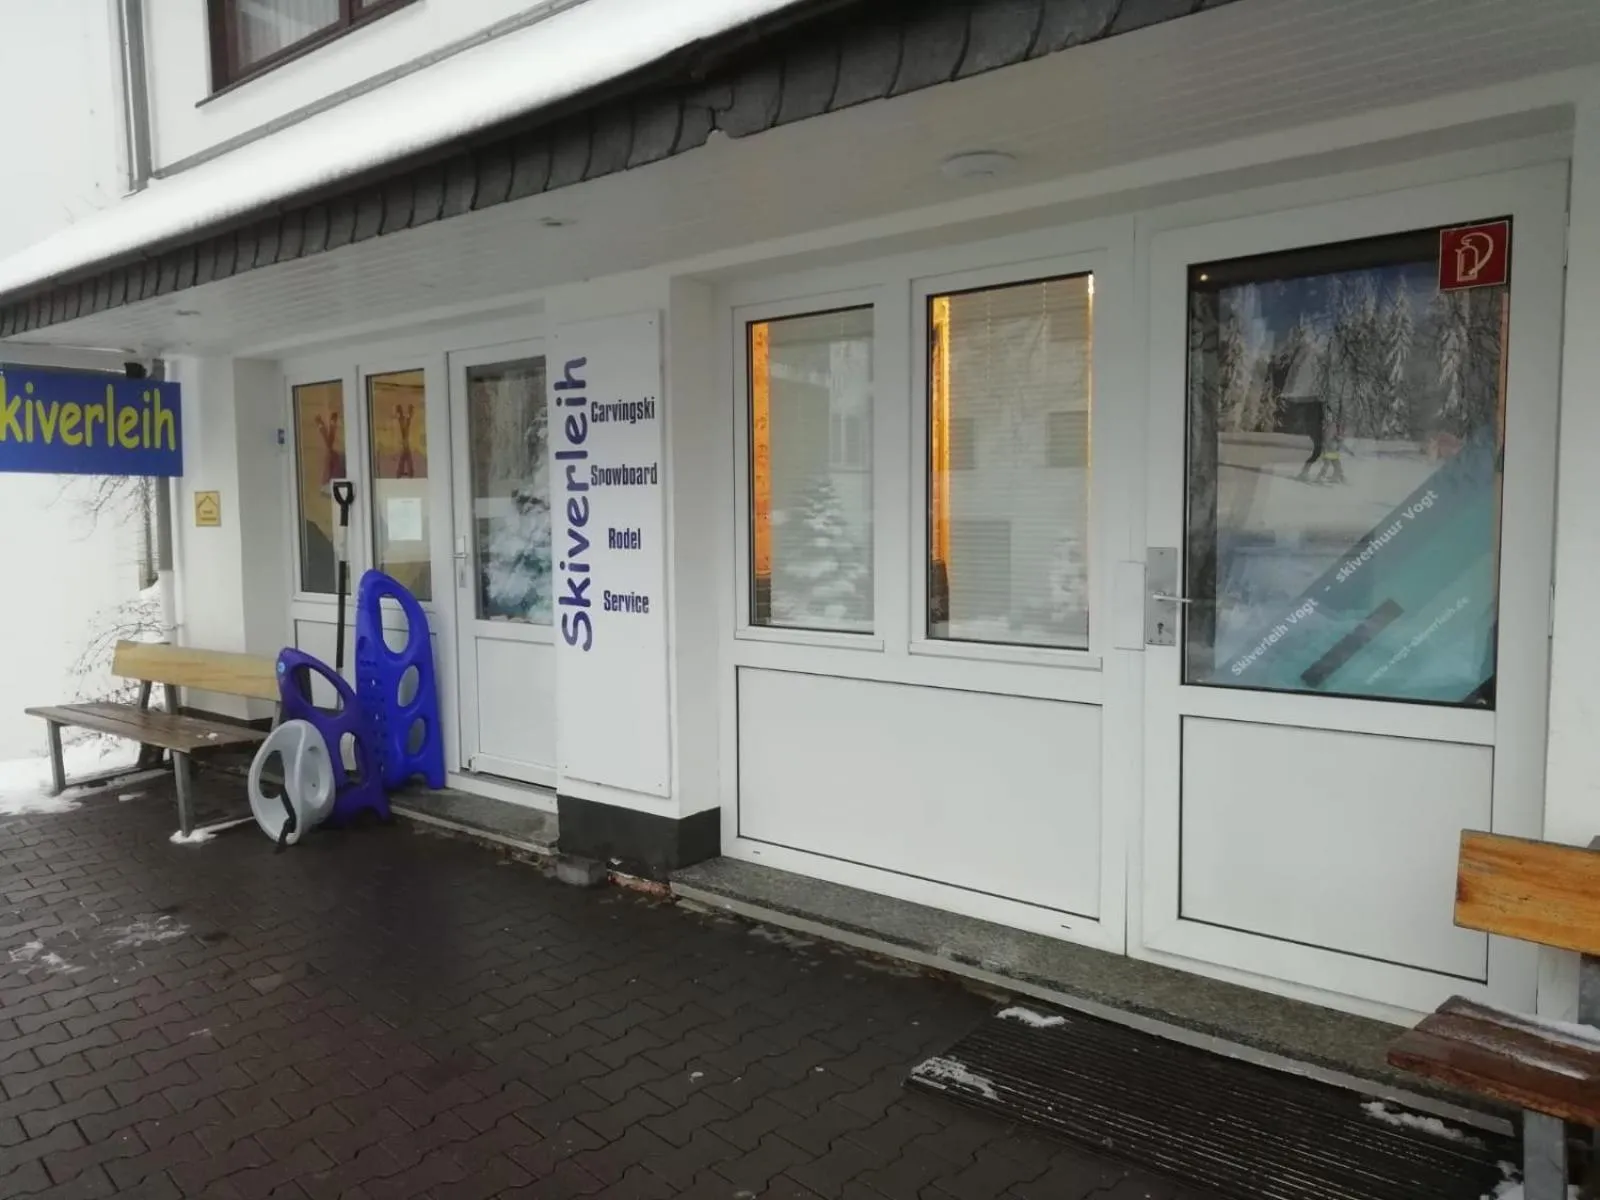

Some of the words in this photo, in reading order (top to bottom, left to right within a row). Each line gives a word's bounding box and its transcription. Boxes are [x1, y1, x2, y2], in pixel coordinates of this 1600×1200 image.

[0, 375, 176, 452] kiverleih
[591, 396, 655, 424] Carvingski
[591, 461, 658, 486] Snowboard
[553, 356, 593, 652] Skiverleih
[608, 527, 642, 550] Rodel
[1231, 624, 1289, 676] Skiverleih
[1285, 598, 1319, 624] Vogt
[1335, 519, 1403, 583] skiverhuur
[1401, 490, 1439, 520] Vogt
[603, 590, 649, 614] Service
